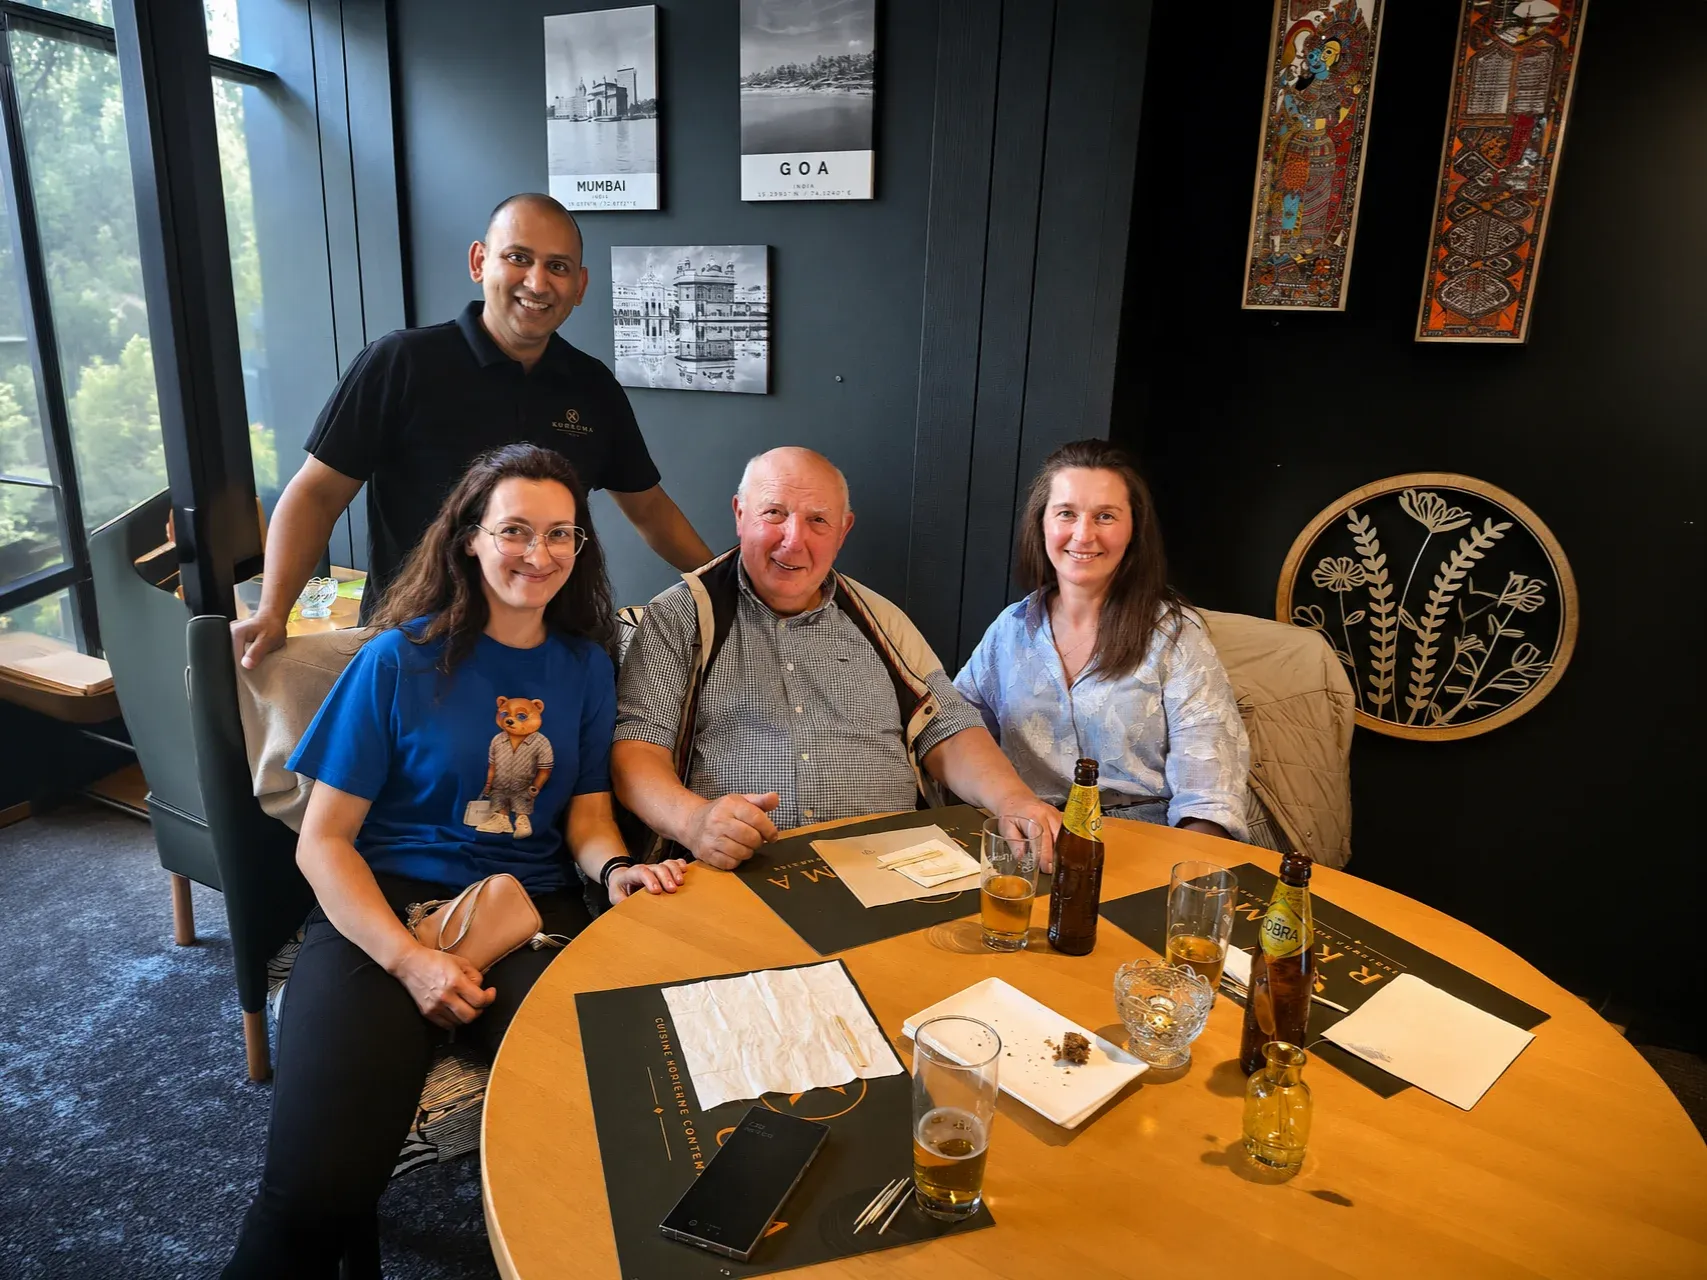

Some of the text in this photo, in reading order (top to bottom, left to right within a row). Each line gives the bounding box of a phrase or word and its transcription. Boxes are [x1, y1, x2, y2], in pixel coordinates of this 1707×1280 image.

[779, 161, 829, 176] GOA
[577, 180, 626, 192] MUMBAI
[1261, 917, 1299, 943] COBRA
[655, 1017, 673, 1057] CUISINE
[683, 1120, 705, 1176] CONTEM
